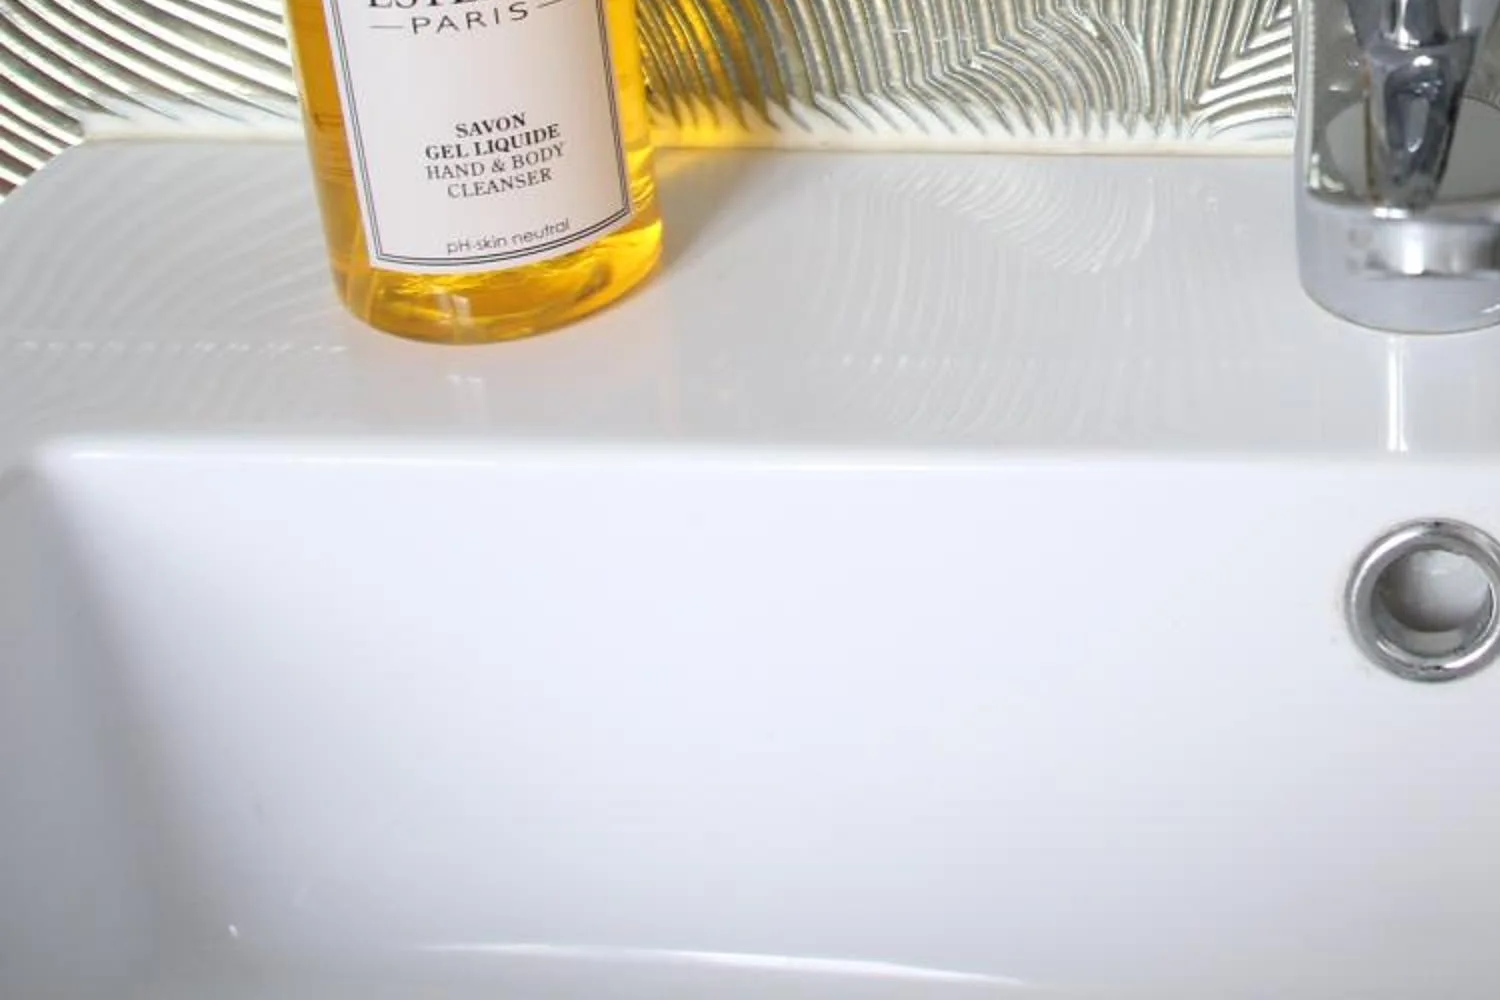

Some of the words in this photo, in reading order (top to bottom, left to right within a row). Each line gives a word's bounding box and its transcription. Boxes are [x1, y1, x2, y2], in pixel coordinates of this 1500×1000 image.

[411, 1, 529, 34] PARIS
[455, 111, 527, 138] SAVON
[425, 144, 469, 160] GEL
[473, 123, 561, 156] LIQUIDE
[425, 161, 485, 180] HAND
[491, 159, 505, 173] &
[511, 141, 565, 169] BODY
[447, 167, 552, 198] CLEANSER
[511, 218, 570, 245] neutral
